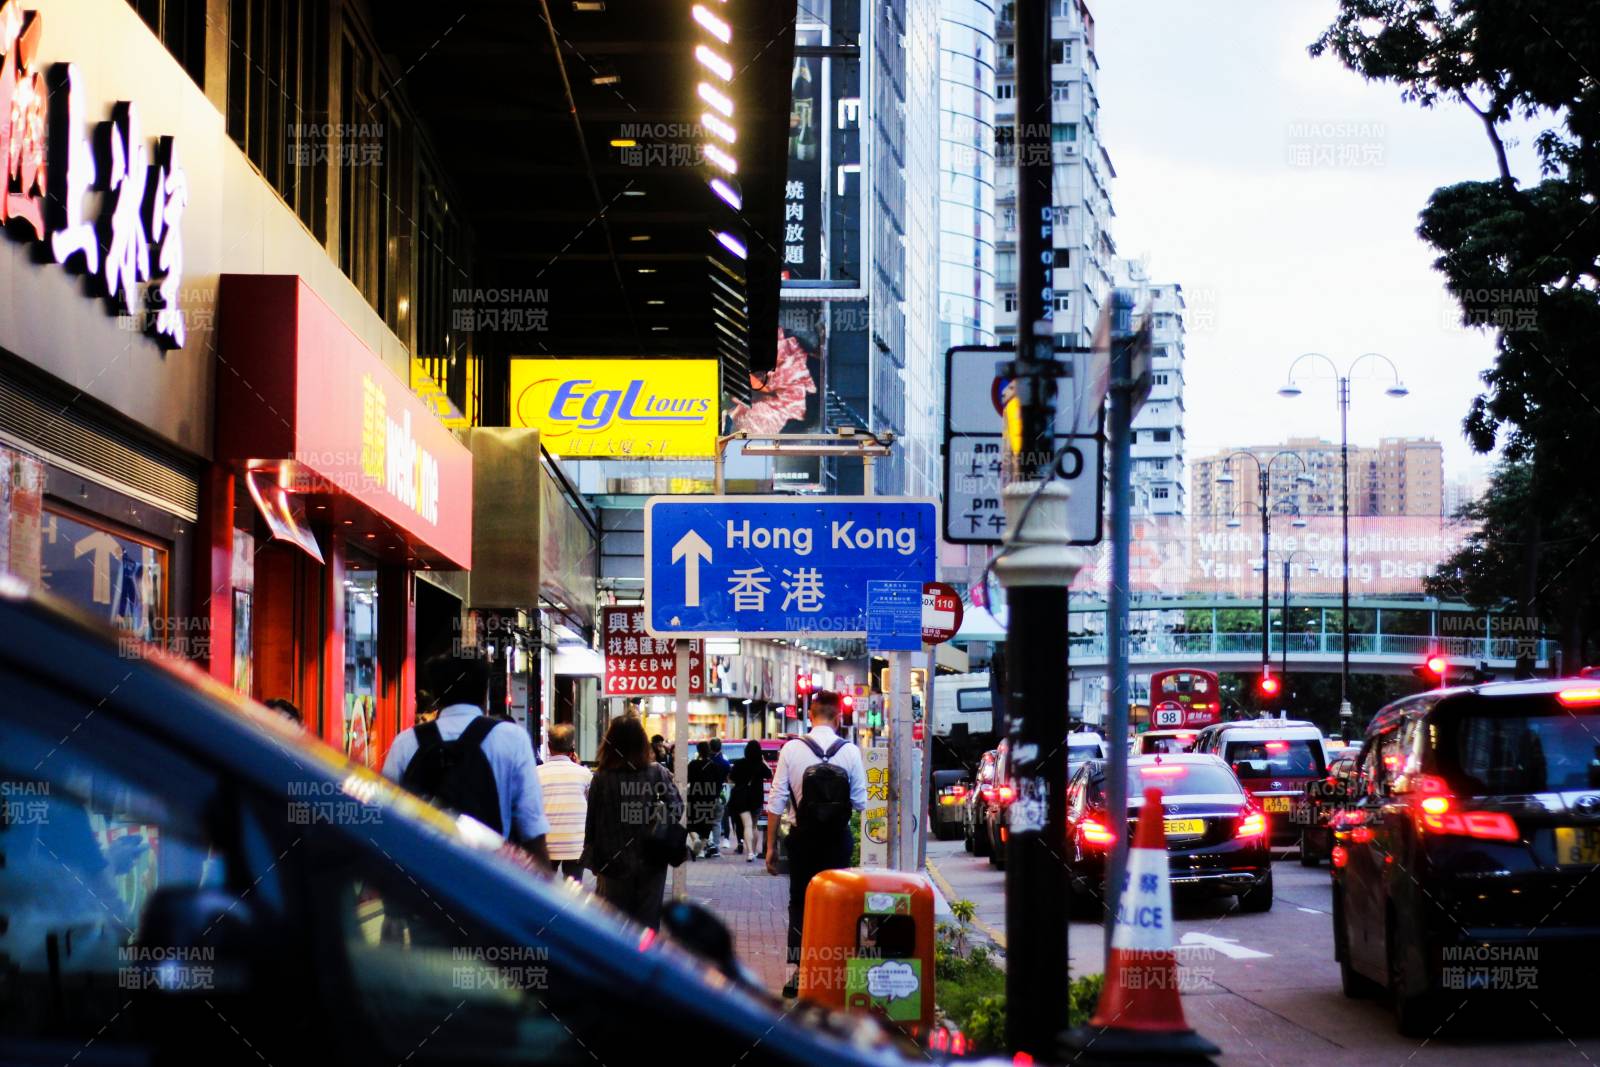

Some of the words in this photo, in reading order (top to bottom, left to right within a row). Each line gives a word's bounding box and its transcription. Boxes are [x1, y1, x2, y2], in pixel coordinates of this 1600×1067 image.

[645, 394, 711, 412] tours
[974, 443, 1000, 454] am
[972, 498, 999, 512] pm
[726, 519, 813, 556] Hong
[831, 520, 916, 556] Kong
[1197, 532, 1252, 551] With
[1197, 559, 1241, 578] Yau
[727, 567, 827, 613] 香港
[937, 600, 953, 608] 110
[618, 676, 658, 690] 3702
[1161, 712, 1177, 723] 98
